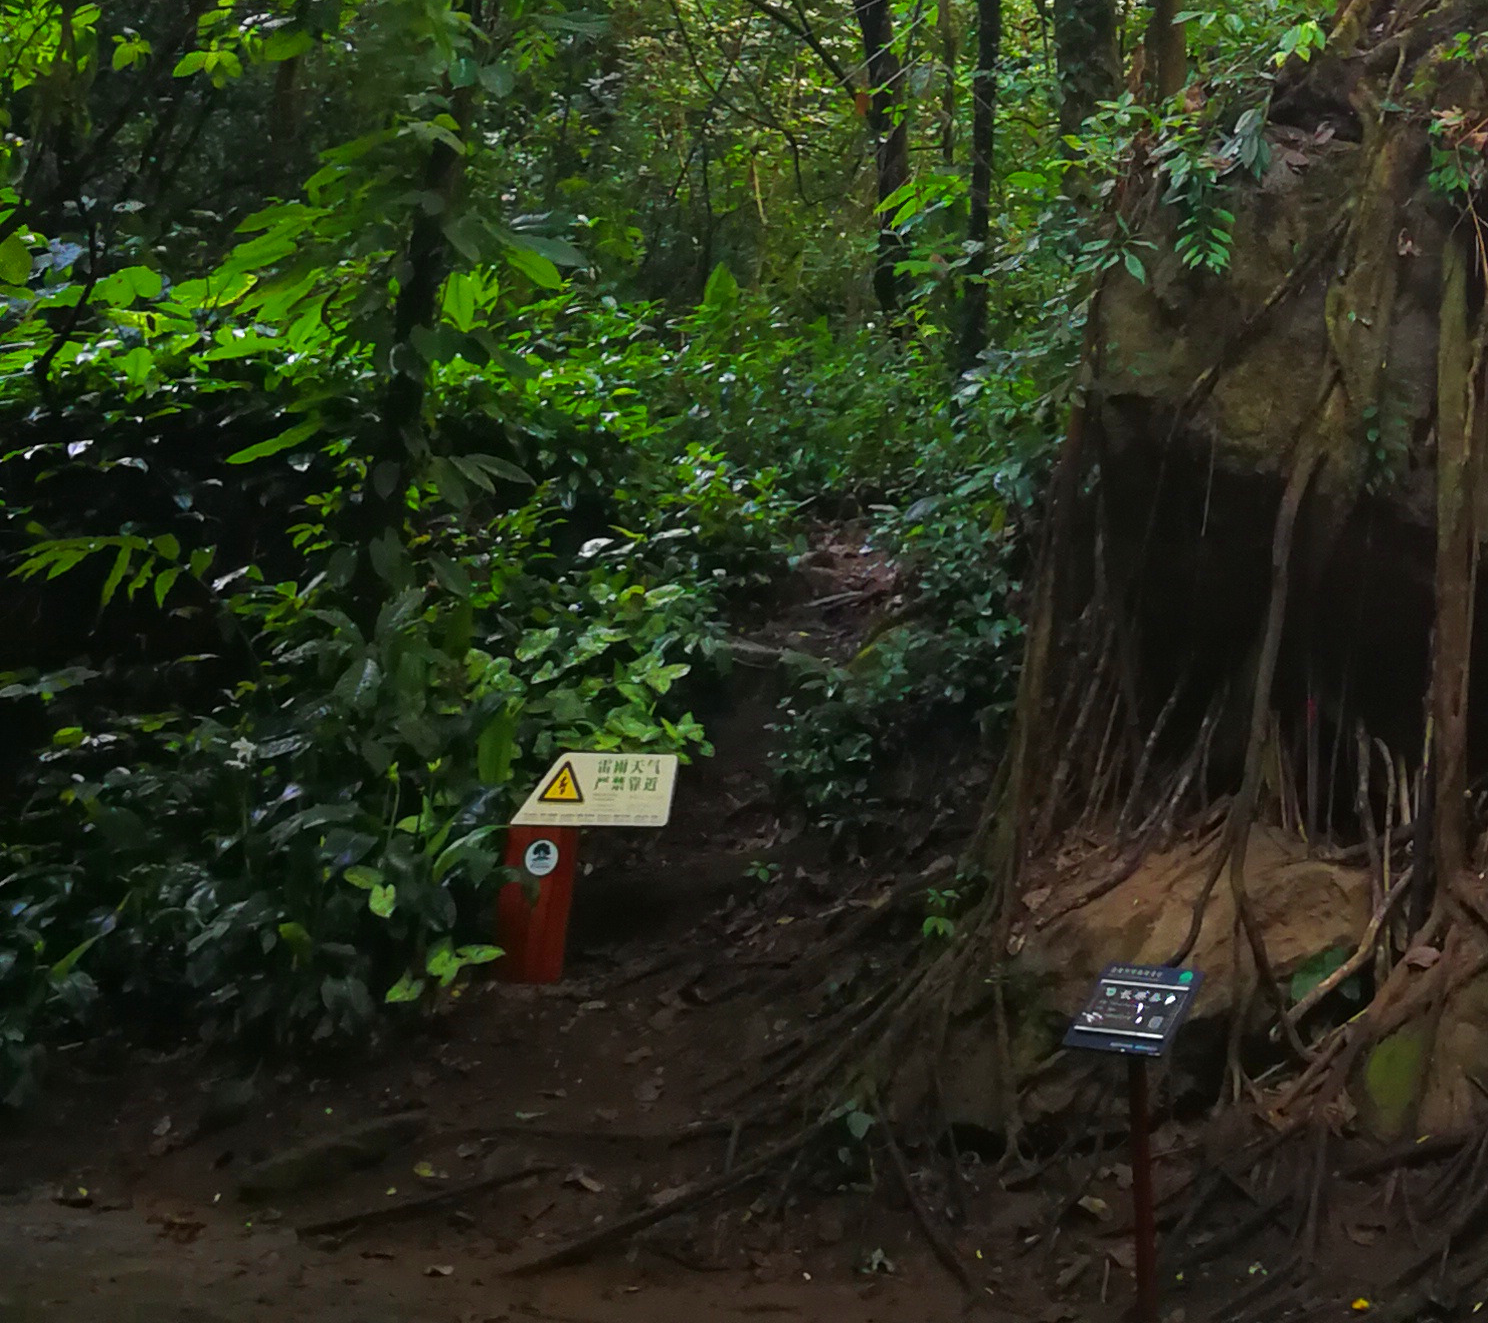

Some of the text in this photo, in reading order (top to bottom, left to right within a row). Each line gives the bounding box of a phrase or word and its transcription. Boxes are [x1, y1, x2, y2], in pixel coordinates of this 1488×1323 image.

[597, 758, 661, 774] 雷雨天气
[594, 777, 658, 792] 严禁靠近
